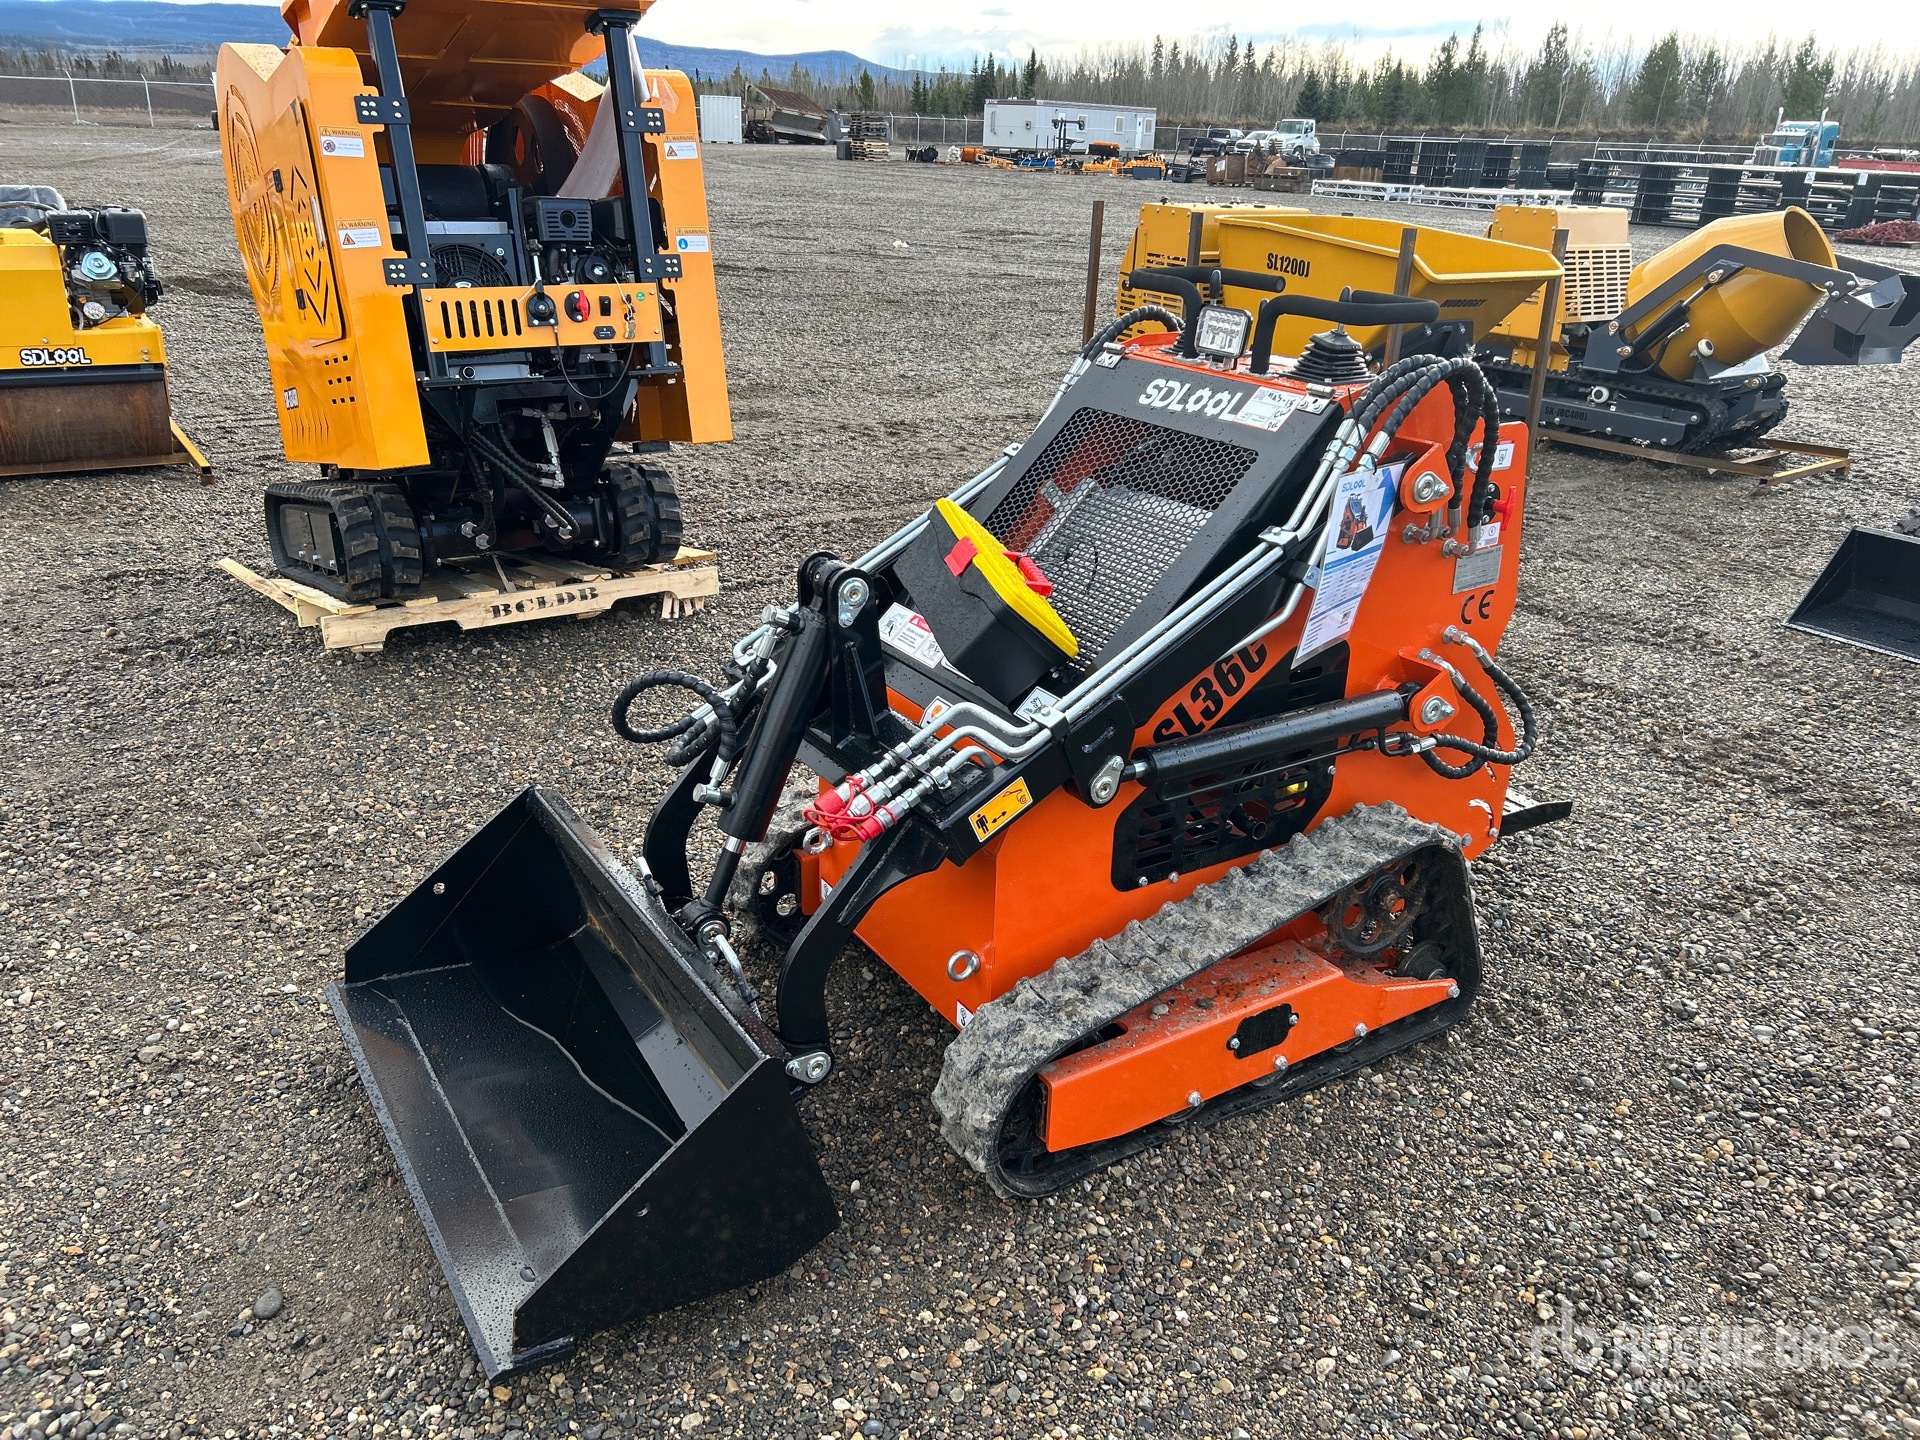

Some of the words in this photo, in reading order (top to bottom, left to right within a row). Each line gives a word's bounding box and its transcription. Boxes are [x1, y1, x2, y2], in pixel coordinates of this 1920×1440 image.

[331, 129, 361, 137] WARNING
[347, 220, 376, 228] WARNING
[1266, 252, 1311, 278] SL1200J
[20, 347, 92, 366] SDLOOL
[1138, 378, 1244, 422] SDLOOL
[1341, 479, 1366, 492] SDLOOL
[489, 586, 600, 619] BCLDB
[1460, 589, 1495, 625] CE
